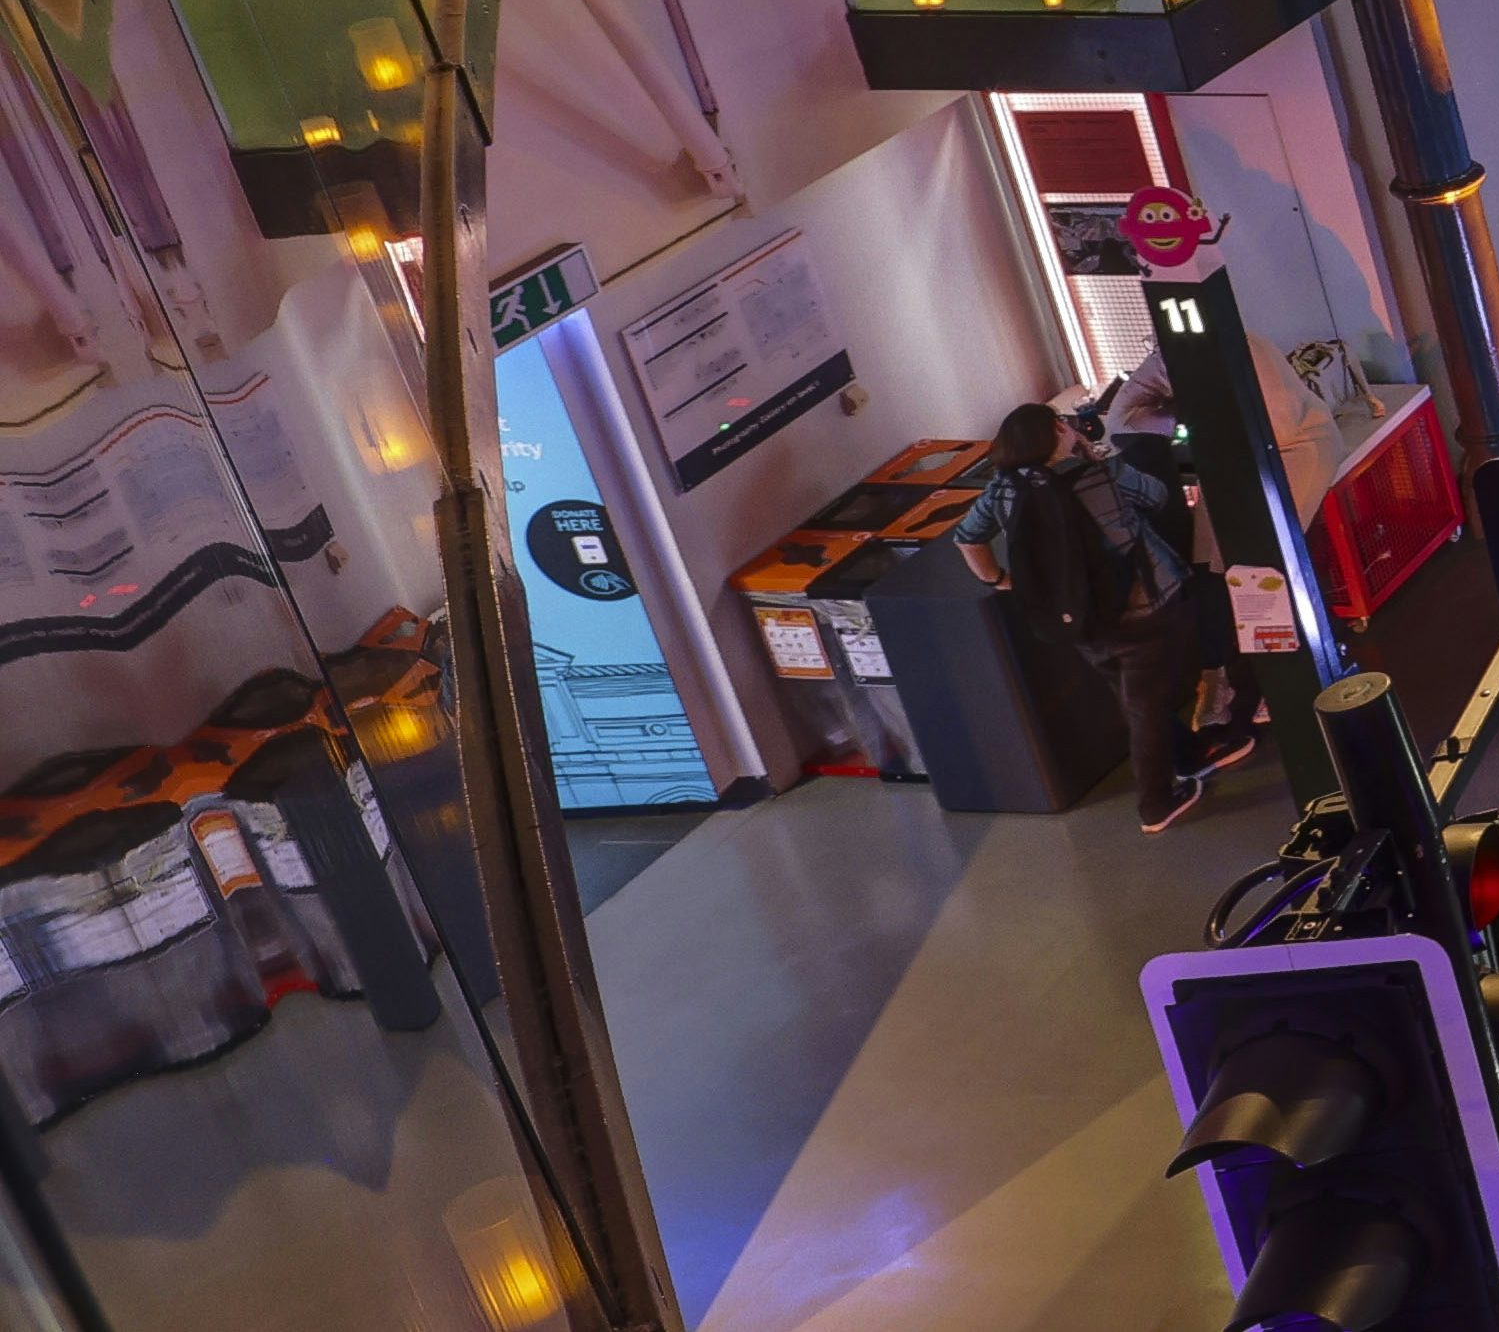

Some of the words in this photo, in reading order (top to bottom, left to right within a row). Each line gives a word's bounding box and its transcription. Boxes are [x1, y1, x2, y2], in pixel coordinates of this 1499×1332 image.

[1160, 298, 1205, 333] 11
[551, 510, 599, 519] DONATE
[555, 519, 604, 532] HERE
